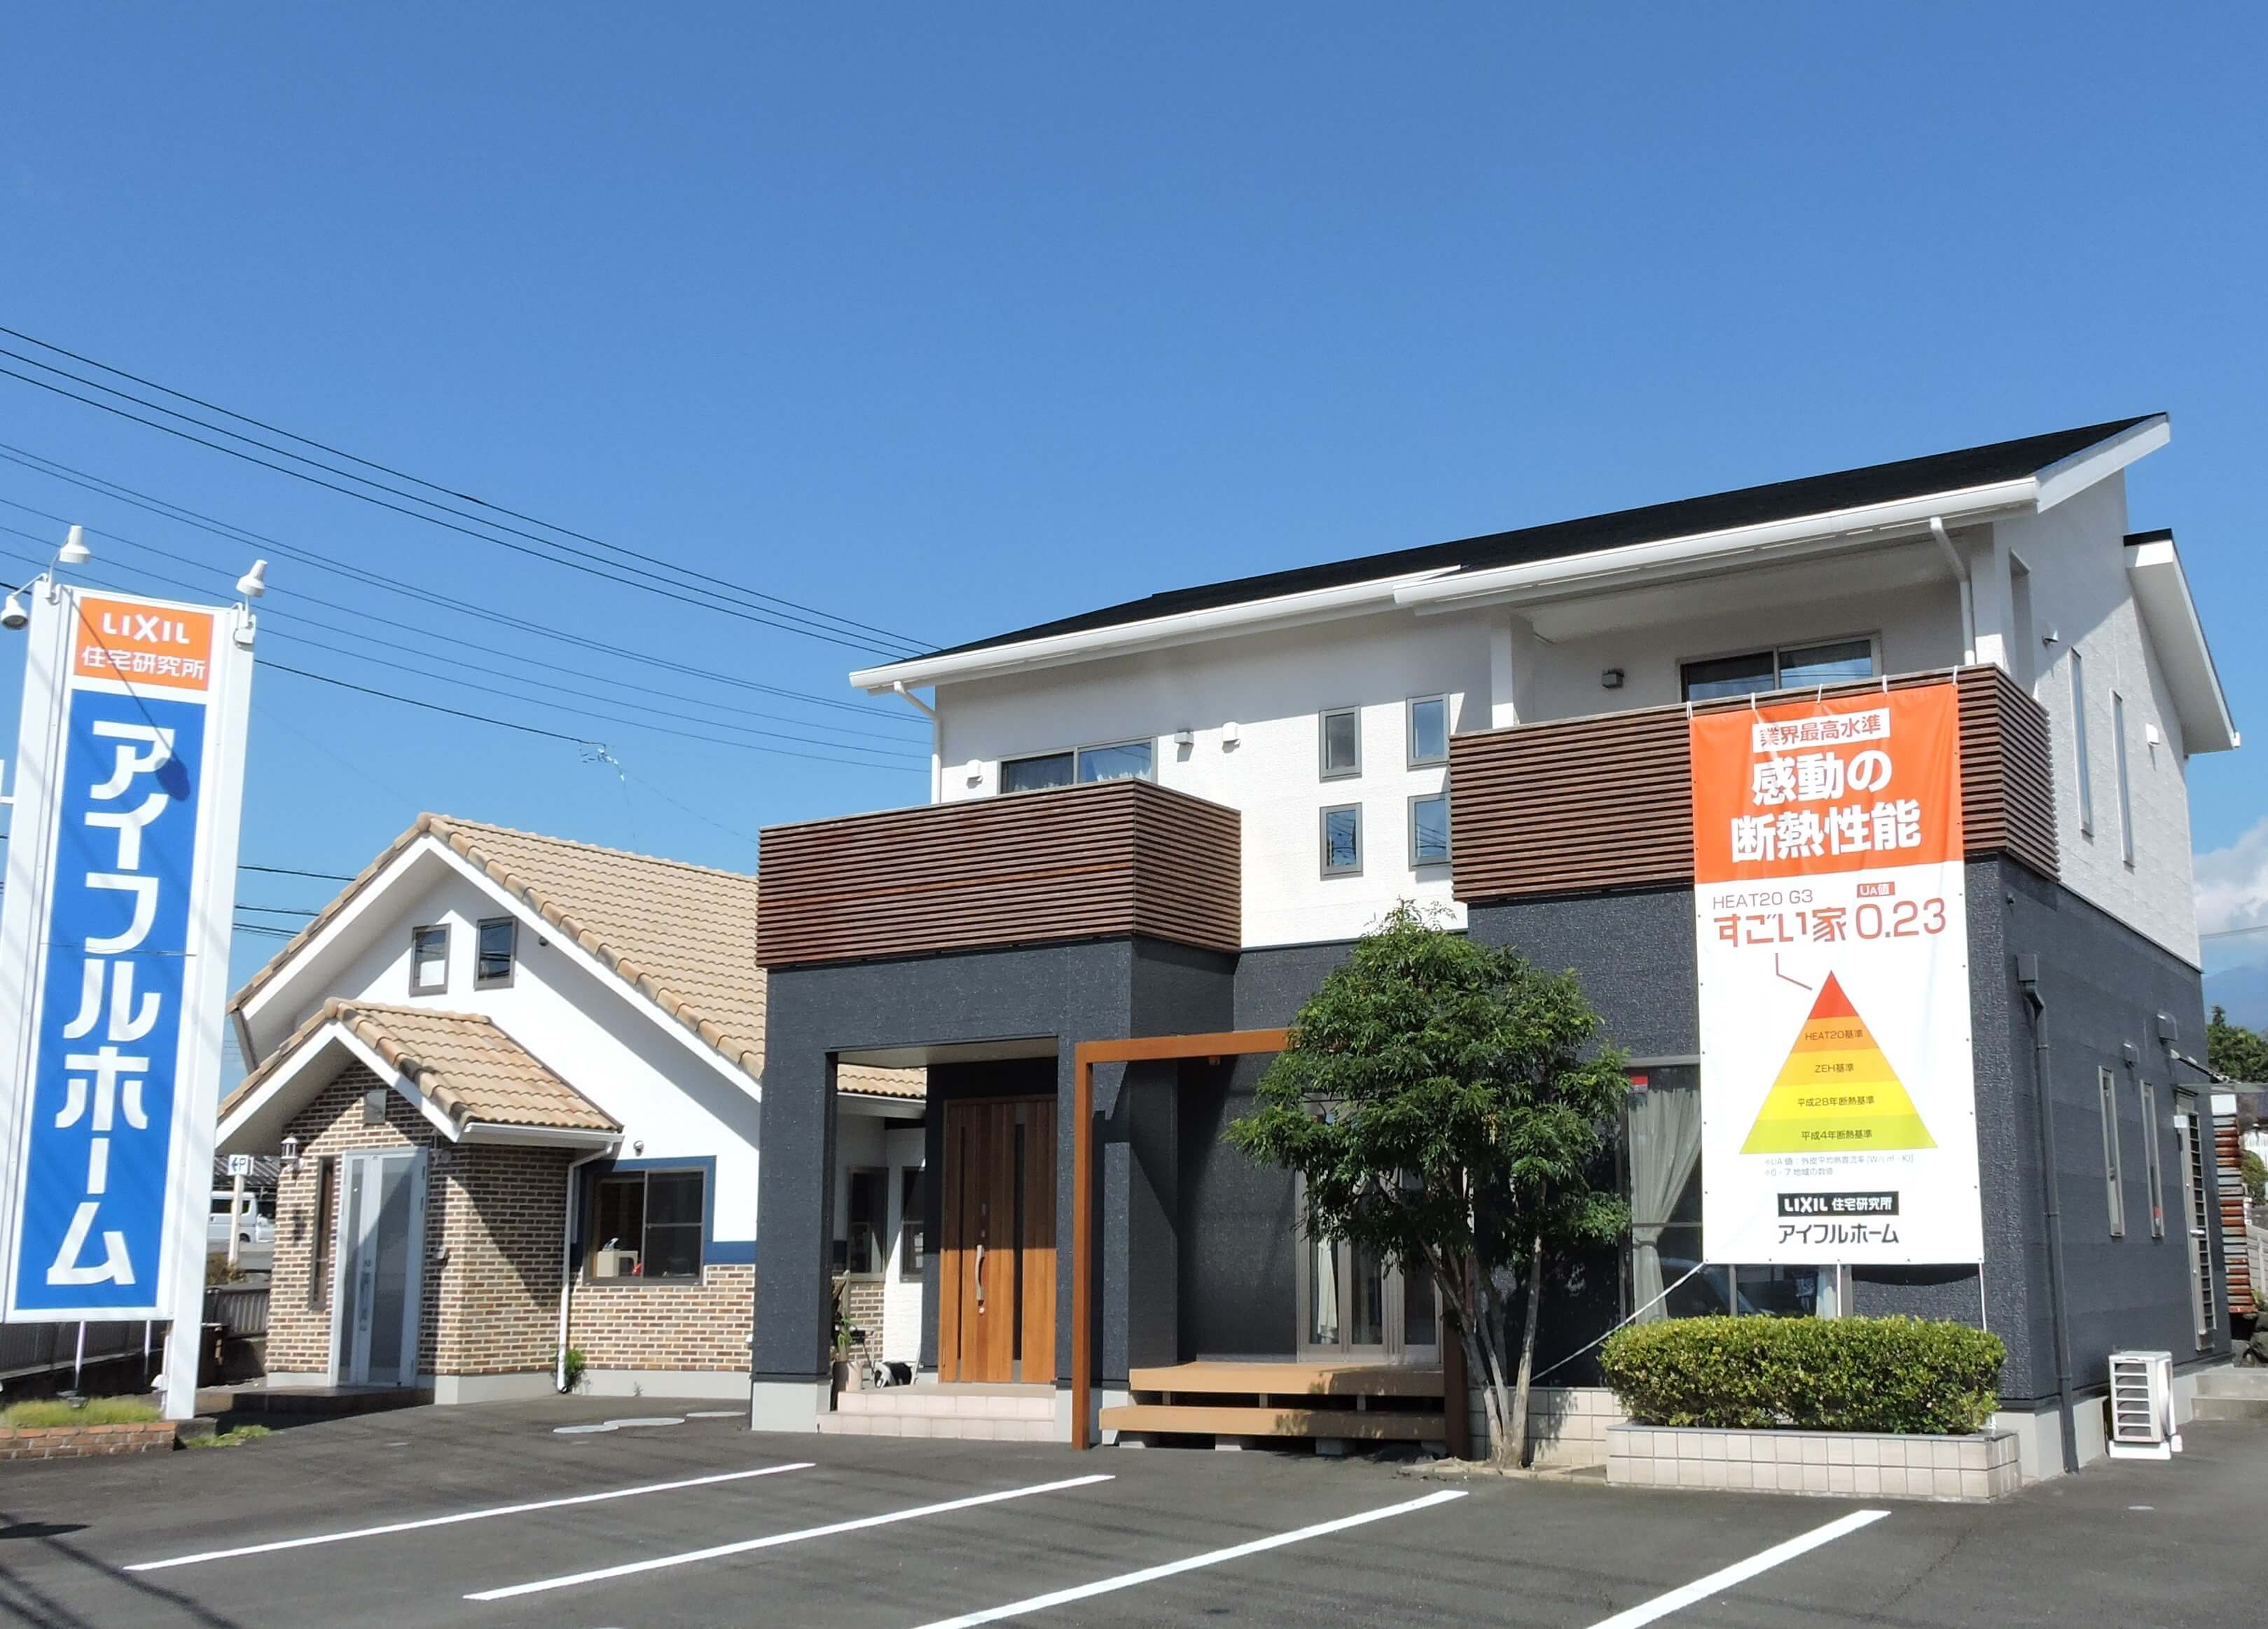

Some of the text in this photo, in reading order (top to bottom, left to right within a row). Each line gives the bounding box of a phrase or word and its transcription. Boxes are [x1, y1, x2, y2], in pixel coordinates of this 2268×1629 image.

[102, 612, 191, 644] LIXIL
[82, 645, 206, 680] 住宅研究所
[1759, 715, 1881, 746] 業界最高水準
[1751, 750, 1893, 806] 感動の
[1731, 799, 1922, 863] 断熱性能
[1713, 889, 1813, 910] HEAT20 G3
[1713, 898, 1946, 947] すごい家 0.23
[47, 720, 174, 1286] アイフルホーム
[238, 1157, 247, 1171] P
[1783, 1197, 1893, 1213] LIXIL 住宅研究所
[1778, 1223, 1900, 1244] アイフルホーム
